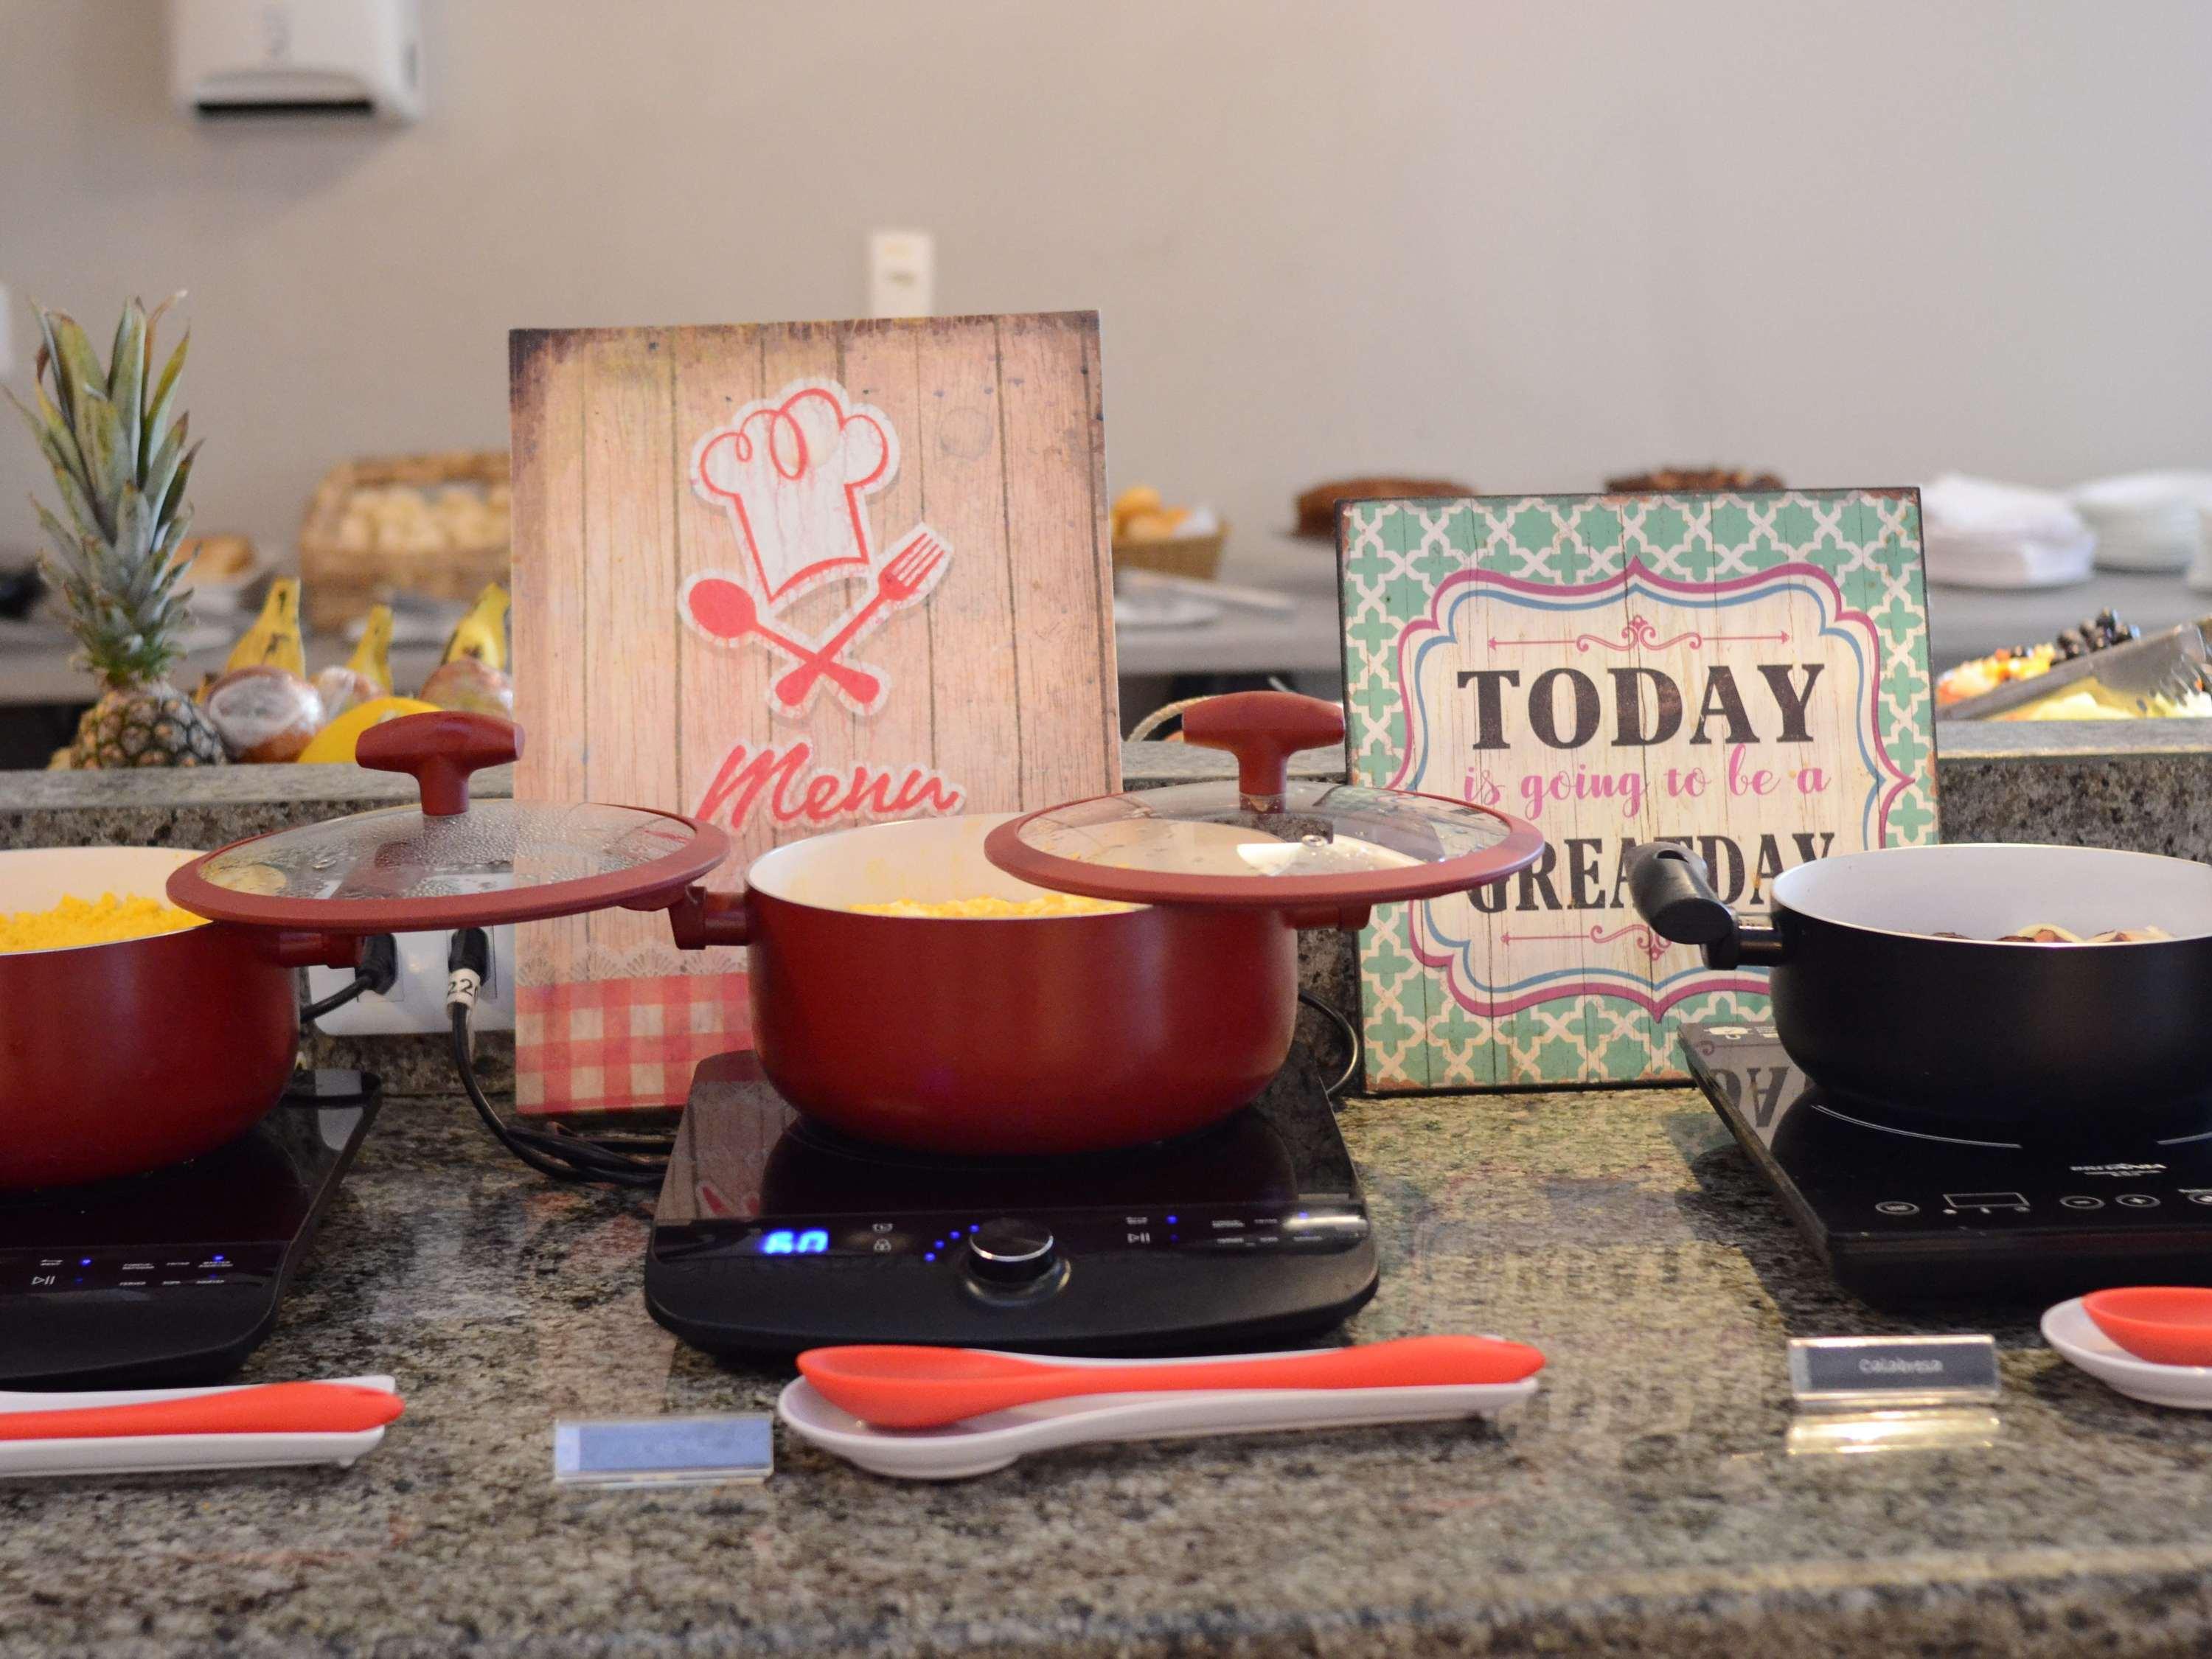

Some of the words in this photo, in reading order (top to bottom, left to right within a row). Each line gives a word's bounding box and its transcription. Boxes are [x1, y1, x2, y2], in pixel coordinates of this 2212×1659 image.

[1457, 664, 1825, 750] TODAY
[695, 742, 959, 830] Menu
[1463, 766, 1506, 806] is
[1520, 763, 1651, 821] going
[1663, 766, 1711, 798] to
[1728, 743, 1781, 796] be
[1796, 767, 1832, 795] a
[1467, 836, 1694, 914] GRE
